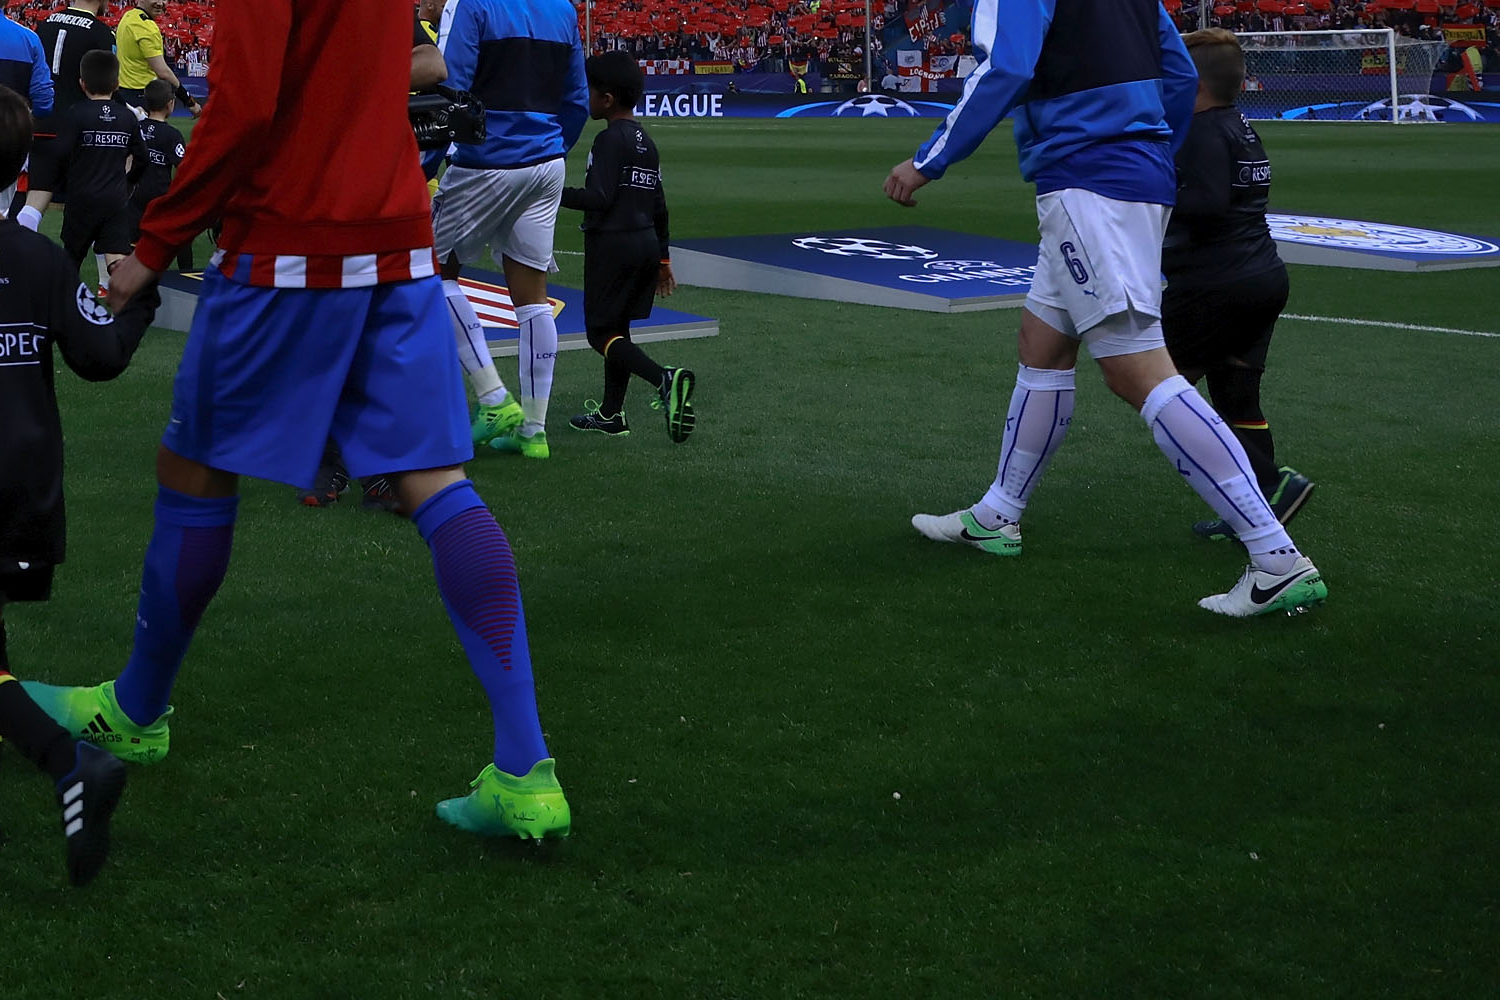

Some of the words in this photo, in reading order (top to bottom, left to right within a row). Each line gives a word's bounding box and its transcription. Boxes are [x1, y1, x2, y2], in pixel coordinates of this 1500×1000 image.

[46, 12, 94, 30] SCHMEICHEL
[52, 29, 68, 76] 1
[632, 93, 724, 117] LEAGUE
[95, 134, 130, 145] RESPECT
[1060, 241, 1089, 285] 6
